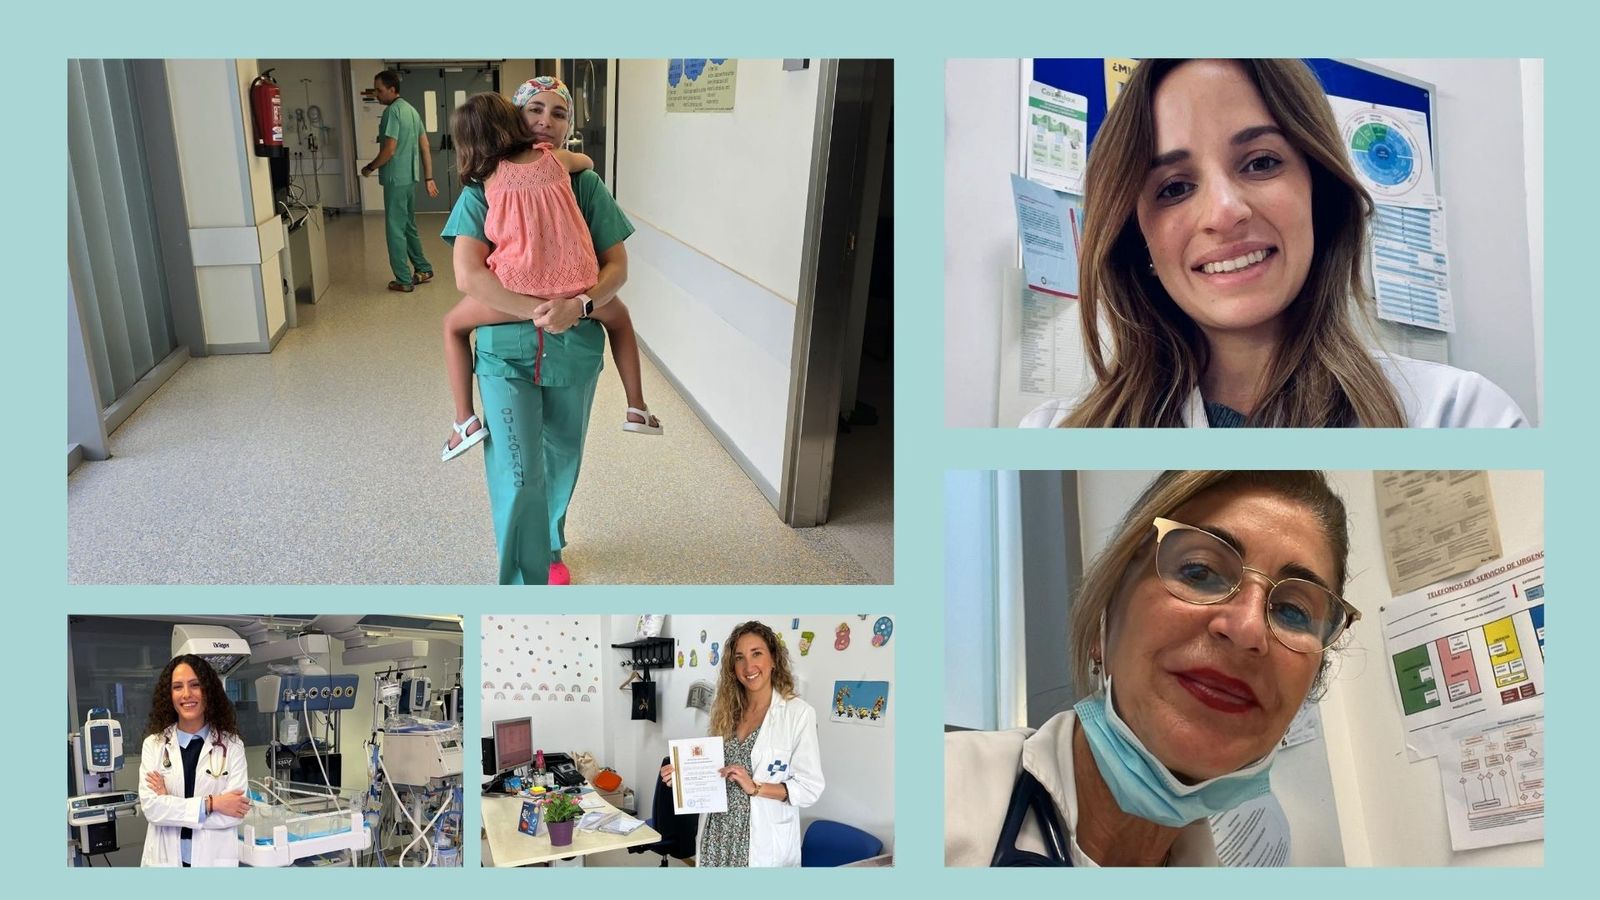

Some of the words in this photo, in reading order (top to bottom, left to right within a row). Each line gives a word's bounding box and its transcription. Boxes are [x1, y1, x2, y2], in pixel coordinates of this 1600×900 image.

[1427, 583, 1463, 599] TELEFONOS
[1464, 578, 1475, 588] DEL
[1476, 566, 1506, 583] SERVICIO
[1507, 562, 1516, 570] DE
